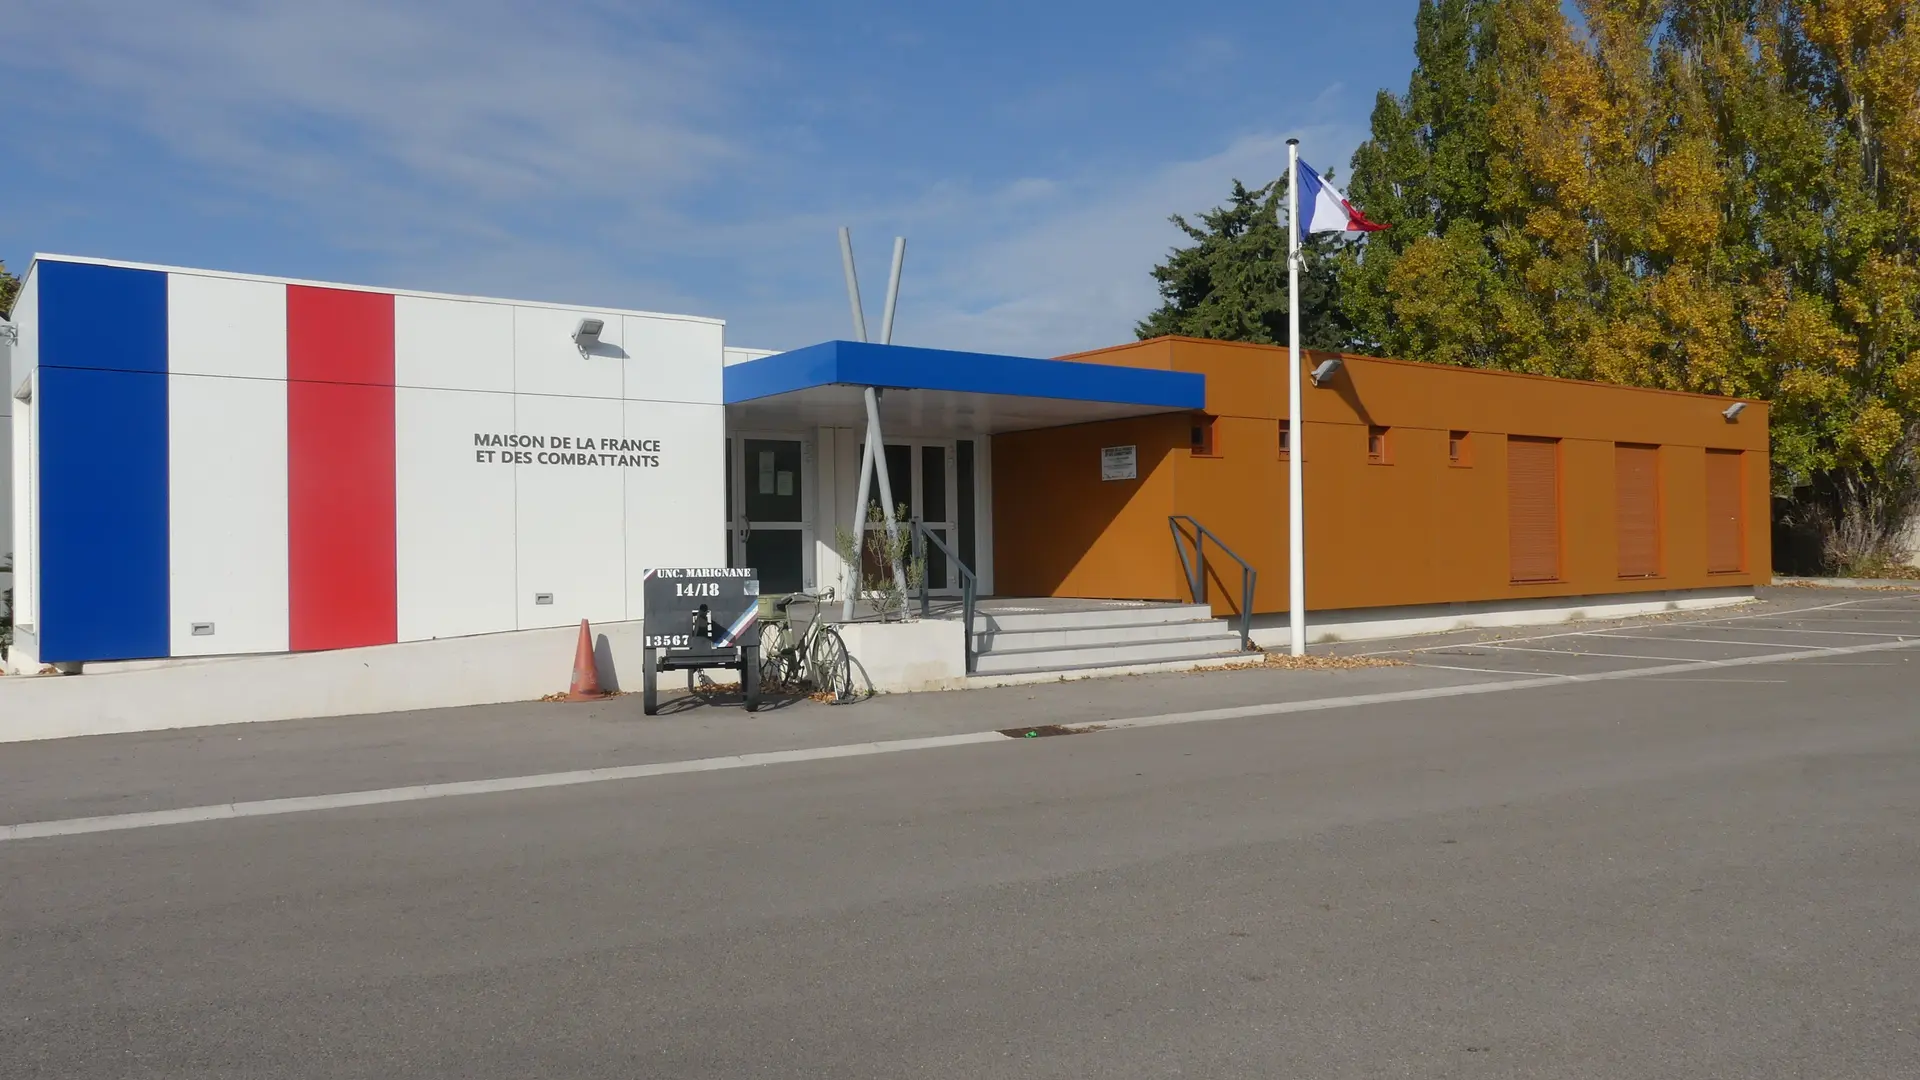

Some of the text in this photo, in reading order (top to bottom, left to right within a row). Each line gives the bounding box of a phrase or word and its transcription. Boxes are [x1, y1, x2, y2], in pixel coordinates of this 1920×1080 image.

[474, 433, 661, 452] MAISON DE LA FRANCE
[476, 450, 660, 467] ET DES COMBATTANTS
[686, 568, 751, 578] MARIGNANE
[676, 583, 720, 597] 14/18
[645, 635, 689, 647] 13567
